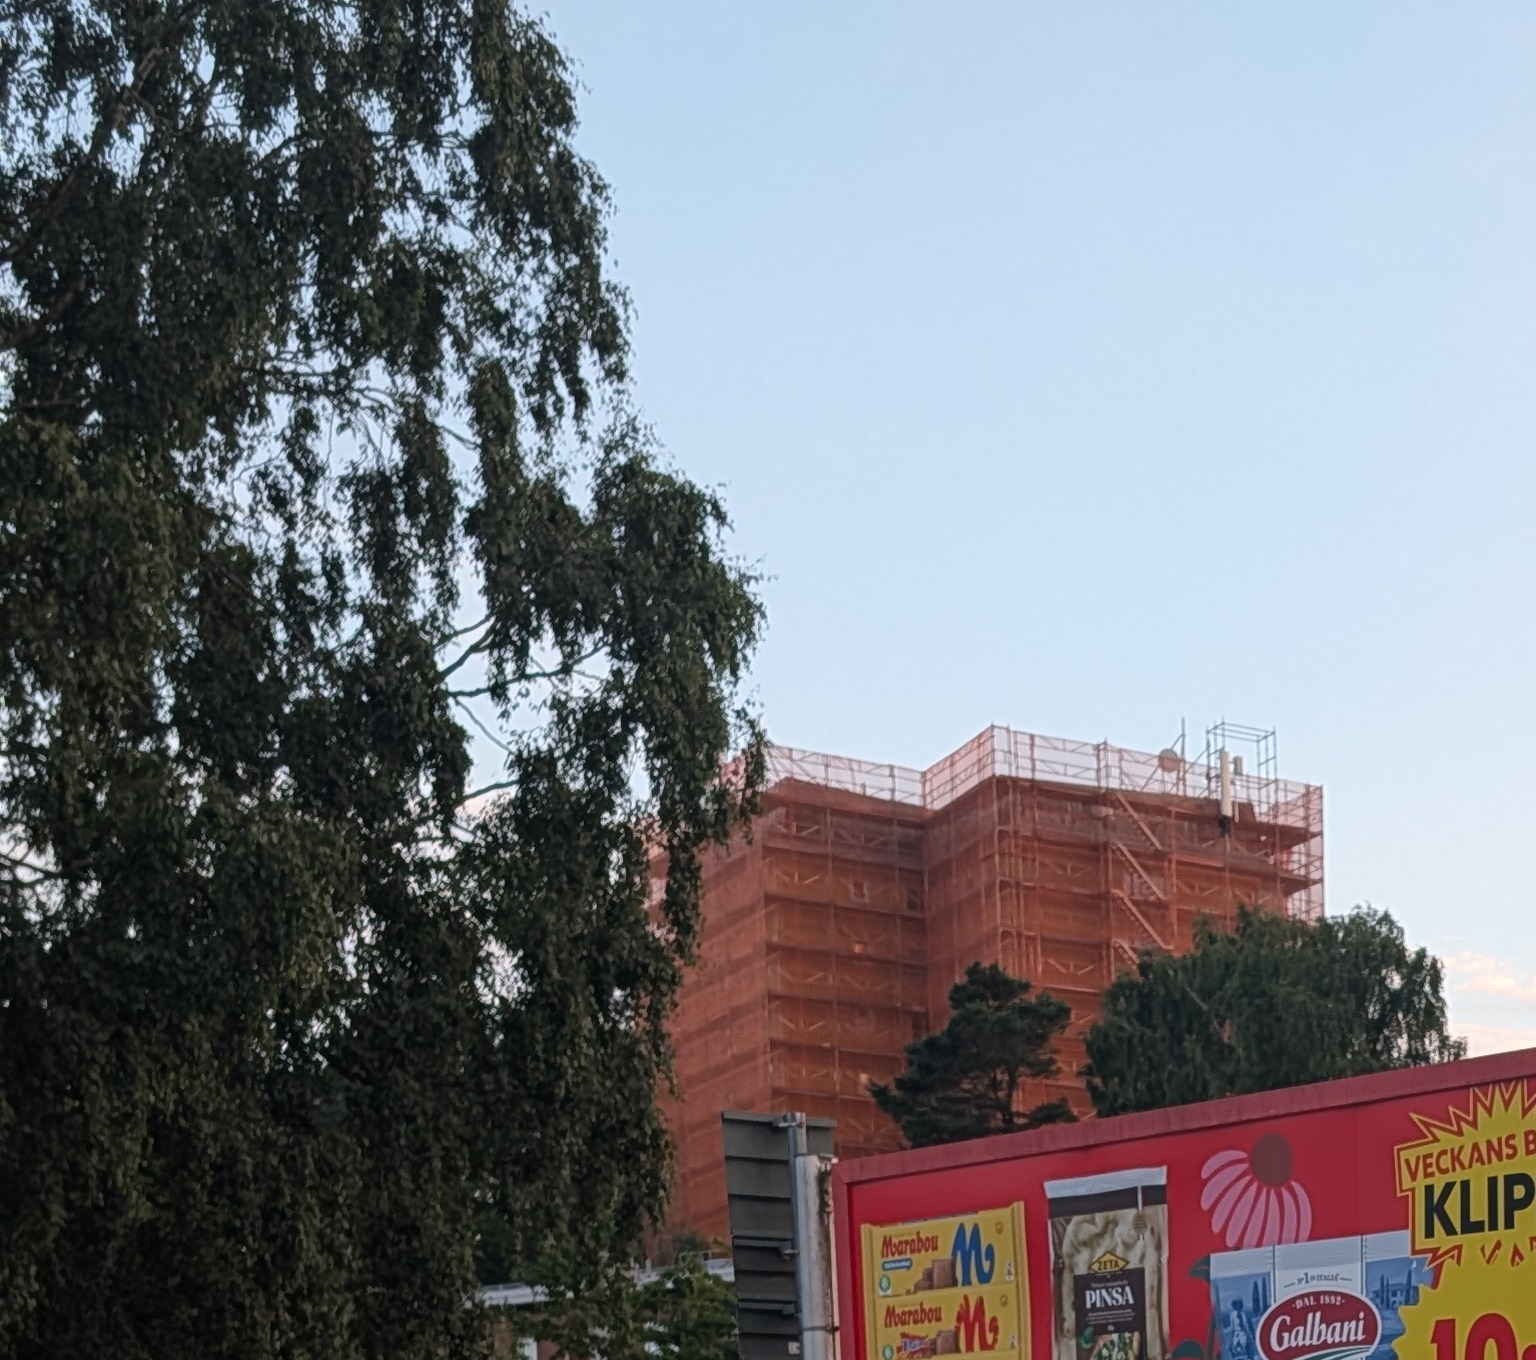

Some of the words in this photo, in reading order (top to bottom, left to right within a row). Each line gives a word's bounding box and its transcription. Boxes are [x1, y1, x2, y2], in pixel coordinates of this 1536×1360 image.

[1404, 1132, 1517, 1182] VECKANS
[881, 1230, 939, 1259] Marabou
[1097, 1259, 1120, 1271] ZETA
[1085, 1286, 1134, 1309] PINSA
[1295, 1295, 1316, 1309] DAL
[884, 1301, 942, 1329] Marabou
[1270, 1311, 1366, 1352] Galbani
